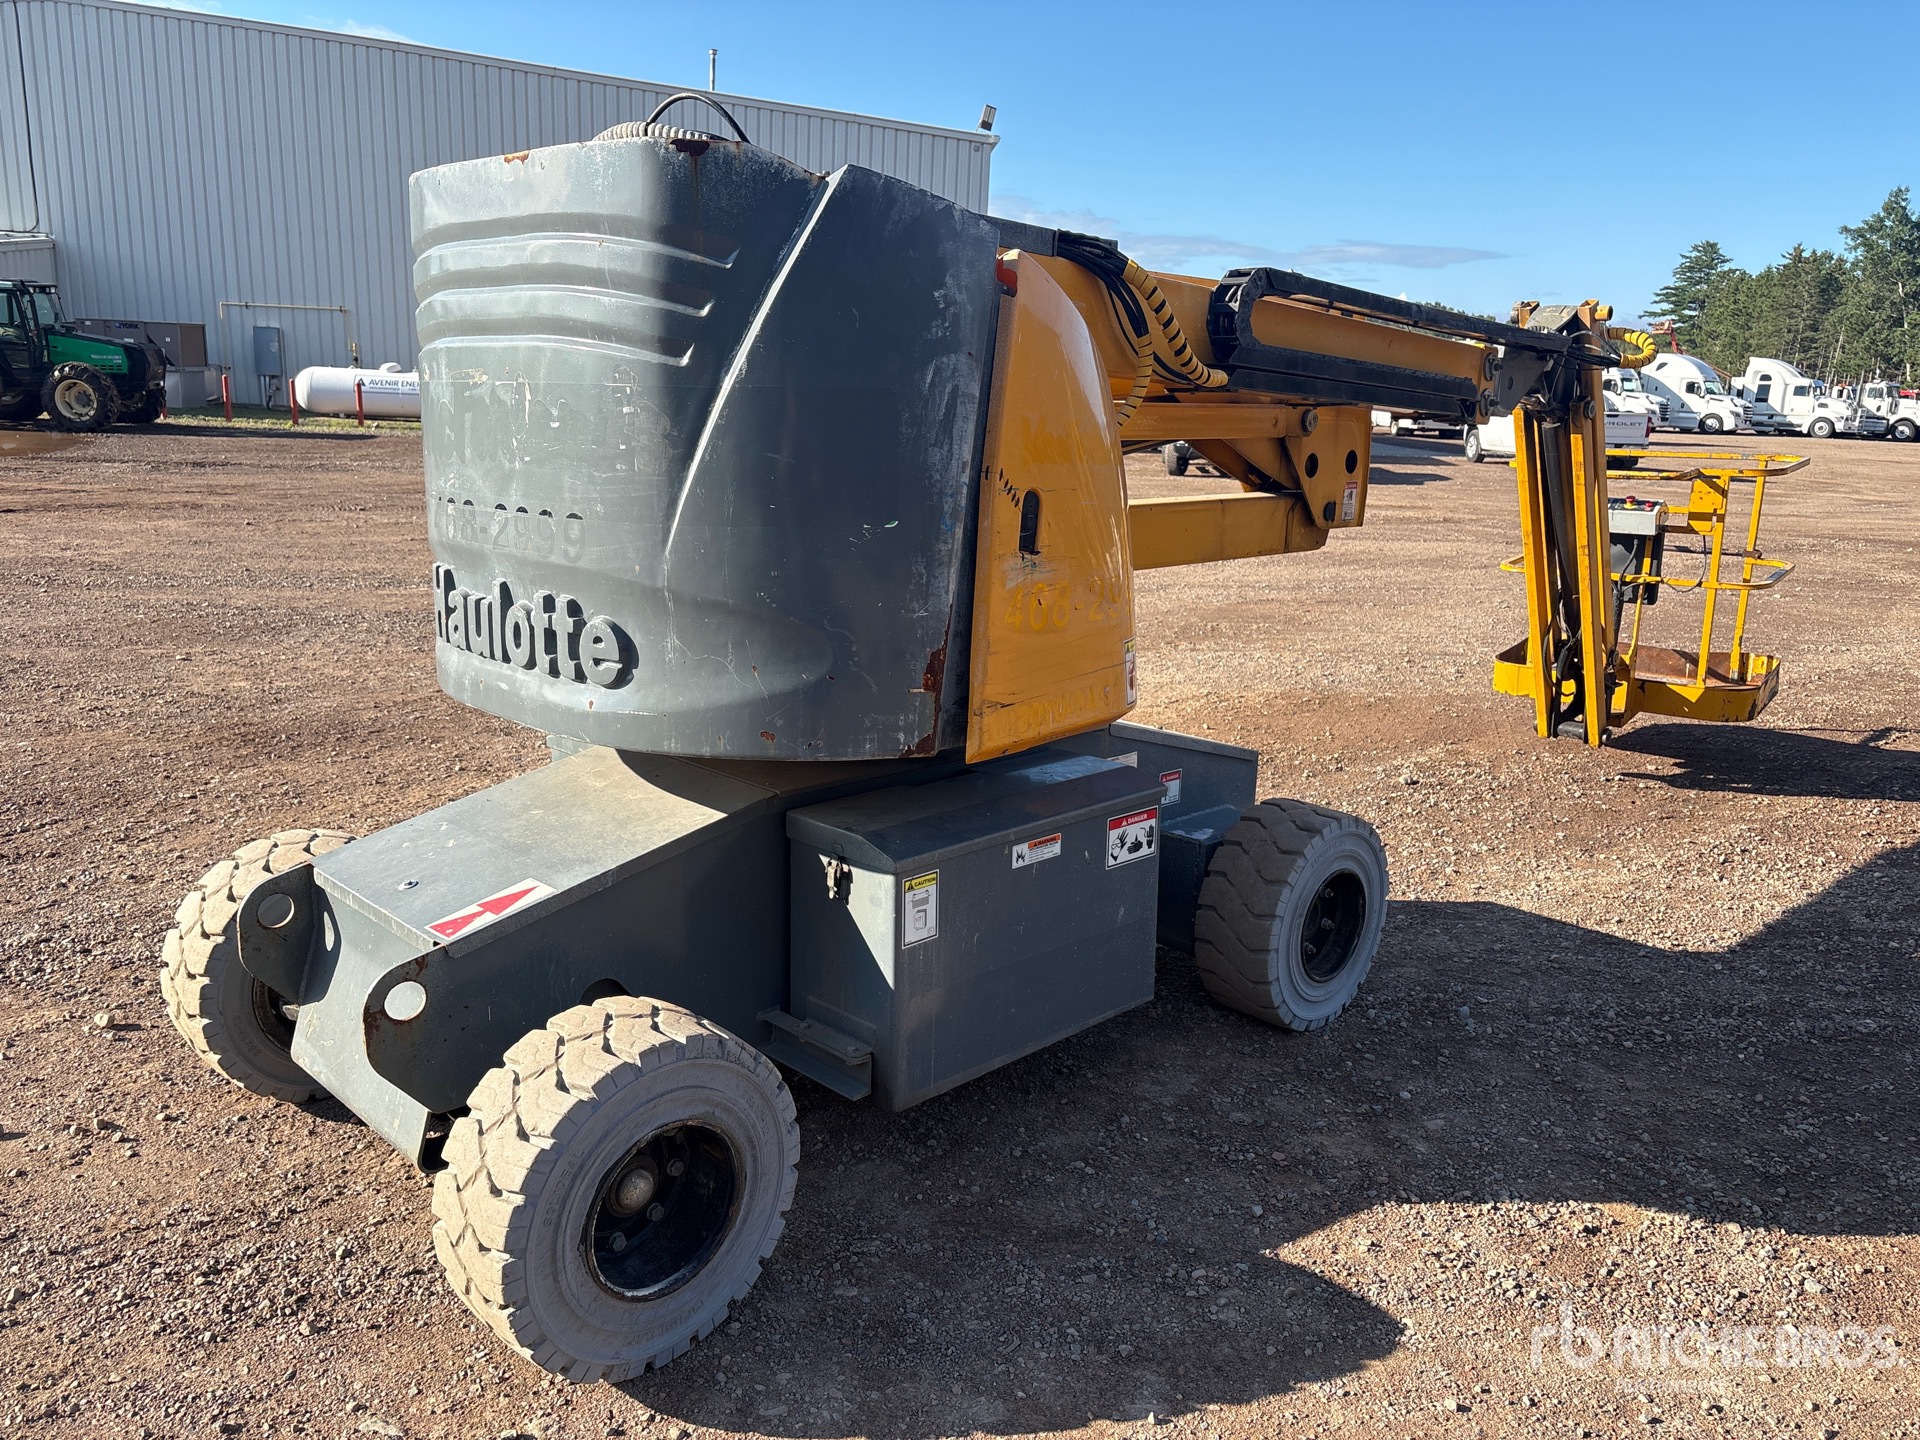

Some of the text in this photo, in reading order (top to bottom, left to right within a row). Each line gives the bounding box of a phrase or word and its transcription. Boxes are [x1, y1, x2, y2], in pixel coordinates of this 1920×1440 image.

[433, 562, 638, 690] Haulotte
[1127, 813, 1148, 824] DANGER
[914, 877, 936, 887] CAUTION
